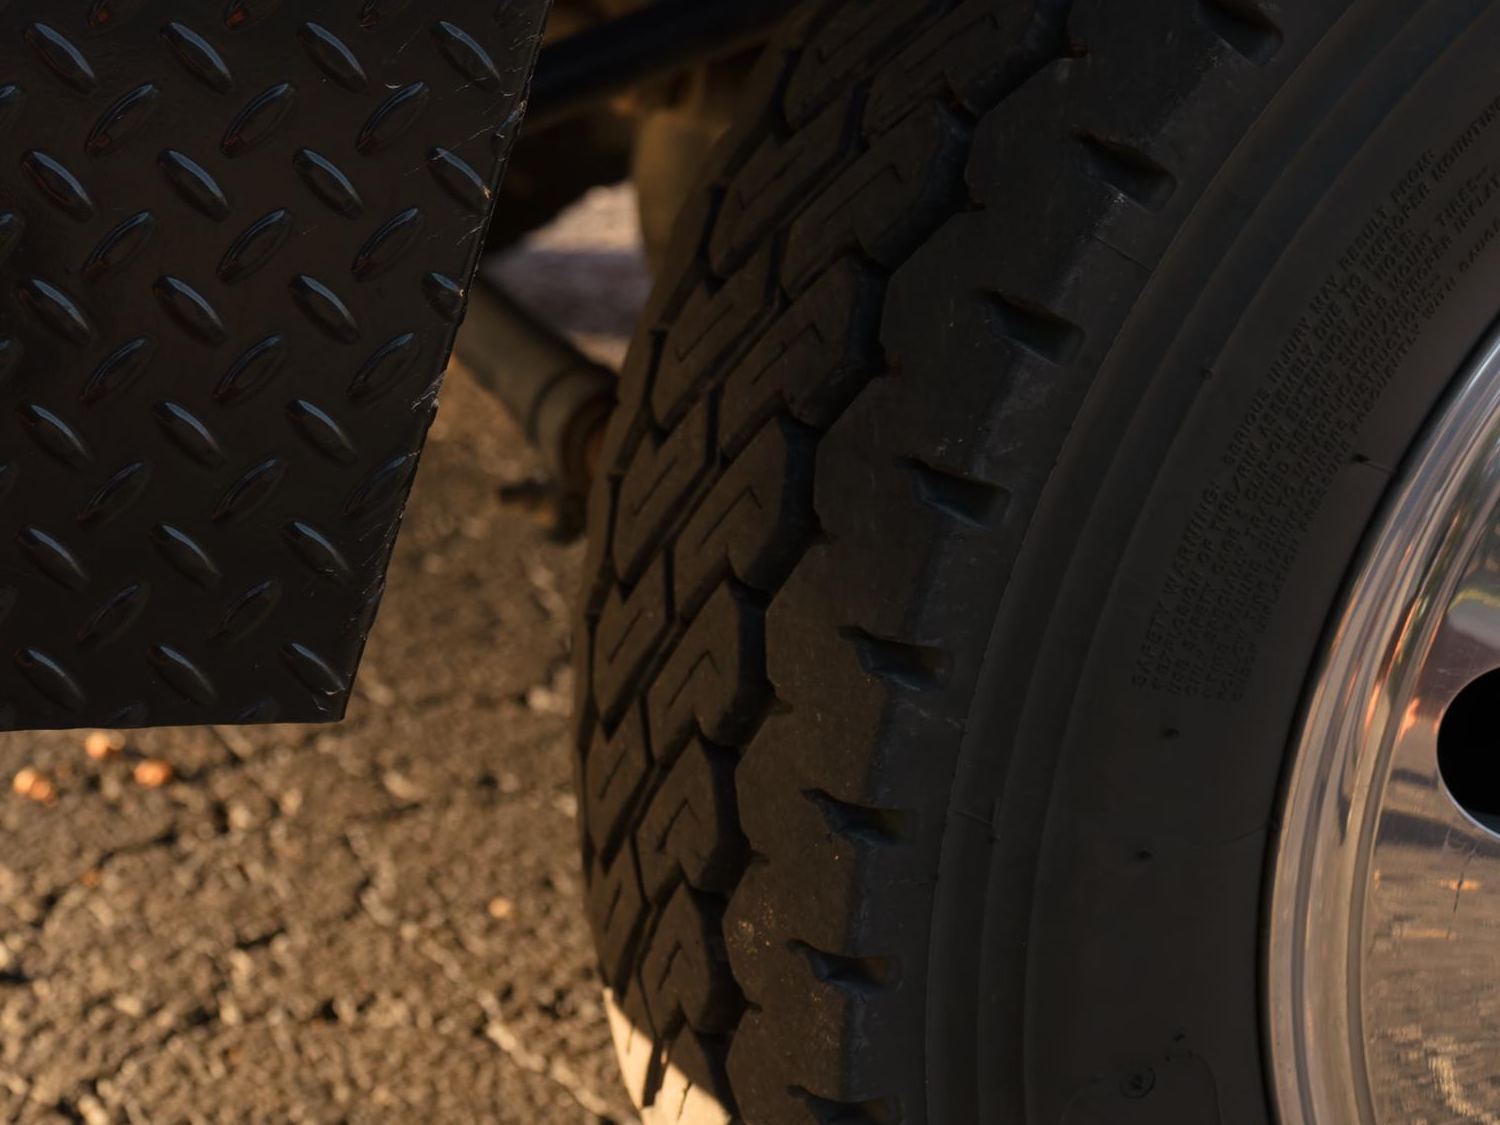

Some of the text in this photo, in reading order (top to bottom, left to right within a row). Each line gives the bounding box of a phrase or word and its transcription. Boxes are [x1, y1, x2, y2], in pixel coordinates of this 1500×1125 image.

[1127, 146, 1436, 688] SAFETY WARNING: SERIOUS INJURY MAY RESULT FROM:
[1165, 656, 1189, 696] USE
[1180, 580, 1217, 652] SAFETY
[1209, 524, 1240, 577] CAGE
[1242, 422, 1289, 502] CLIP-ON
[1284, 316, 1352, 422] EXTENSION
[1348, 282, 1375, 316] AIR
[1195, 537, 1215, 565] OF
[1209, 441, 1260, 534] TIRE/RIM
[1255, 340, 1317, 438] ASSEMBLY
[1312, 300, 1343, 341] DUE
[1339, 270, 1362, 300] TO
[1359, 179, 1431, 271] IMPROPER
[1202, 544, 1249, 644] SPECIALLY
[1243, 458, 1289, 540] TRAINED
[1285, 368, 1339, 455] PERSONS
[1336, 292, 1388, 366] SHOULD
[1386, 229, 1435, 292] MOUNT
[1255, 513, 1280, 553] DUE
[1275, 482, 1295, 510] TO
